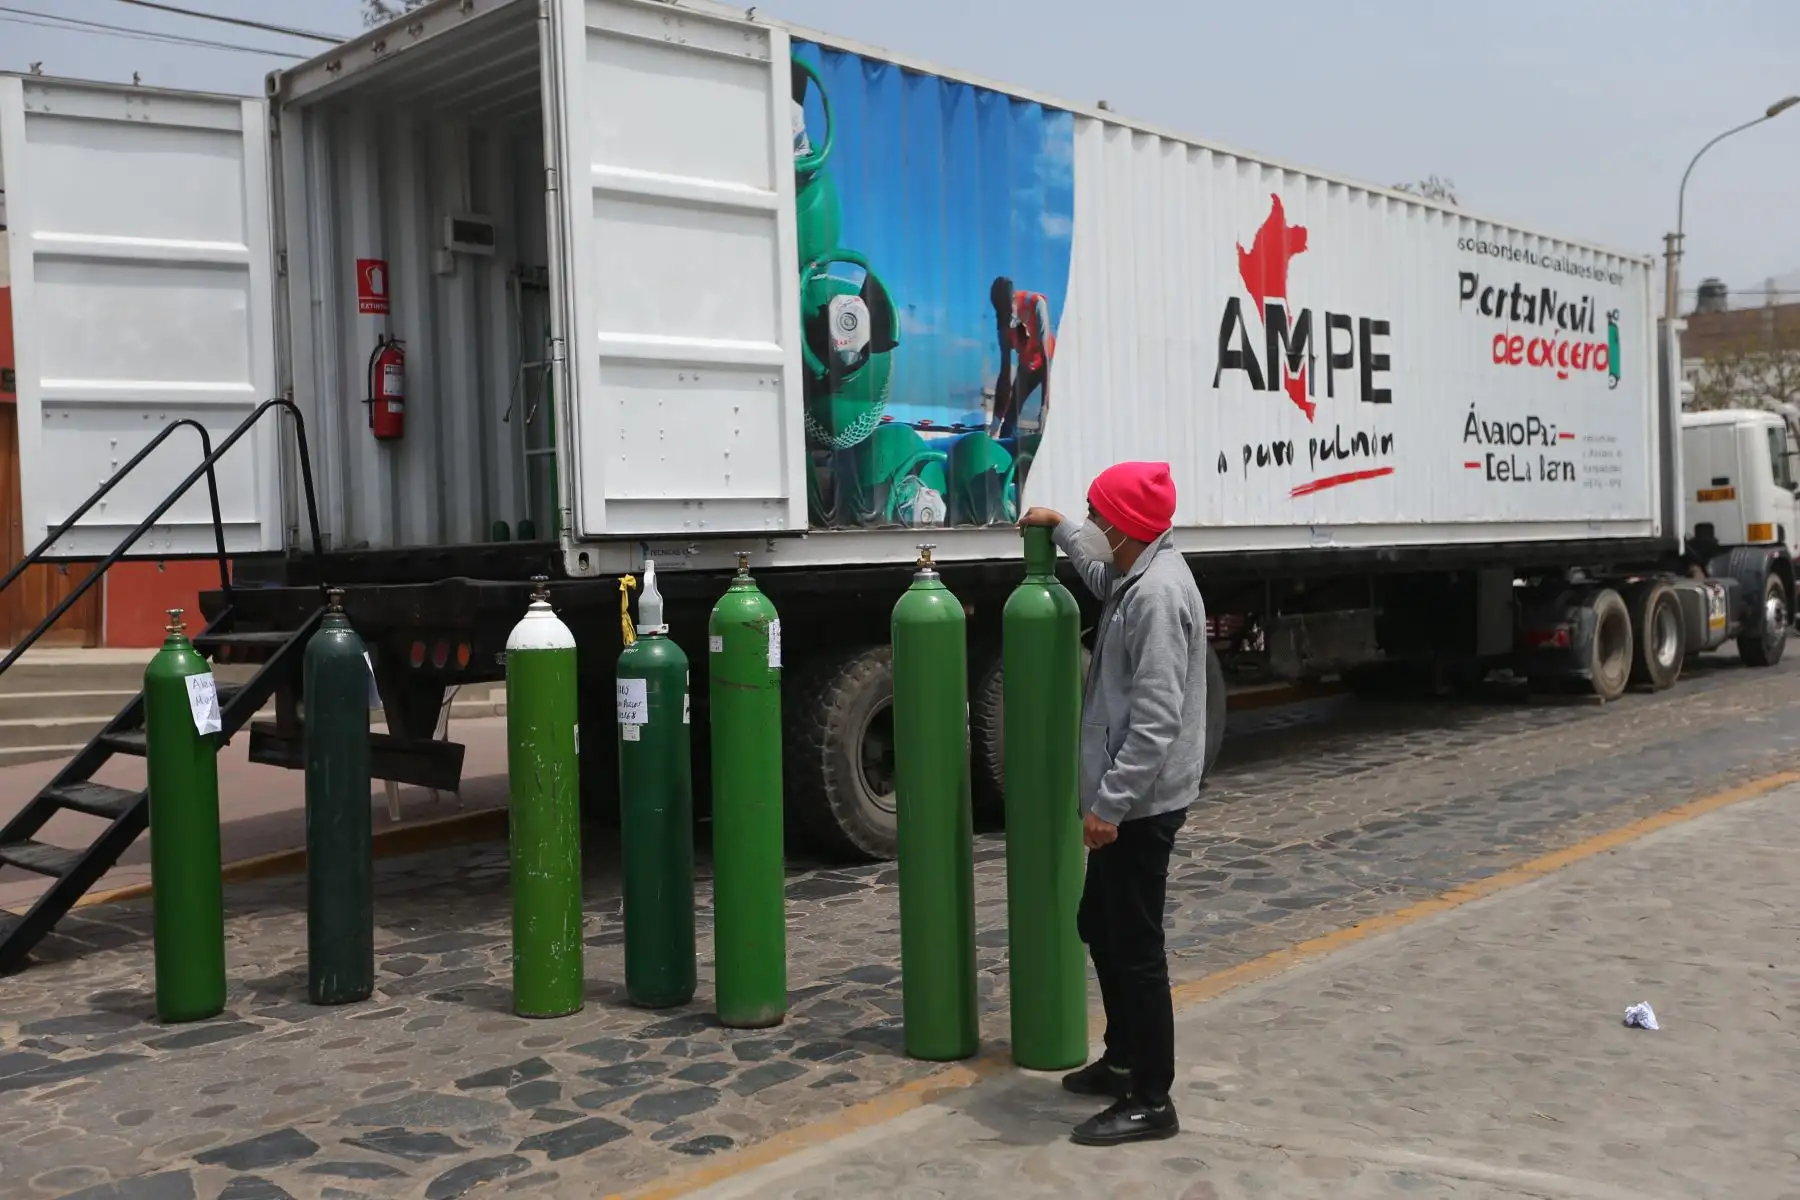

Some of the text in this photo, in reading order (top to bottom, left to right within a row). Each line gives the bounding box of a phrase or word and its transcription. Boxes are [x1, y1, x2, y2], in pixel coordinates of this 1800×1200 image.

[360, 302, 388, 311] EXTINT
[1213, 297, 1393, 404] AMPE
[1243, 440, 1295, 480] puro
